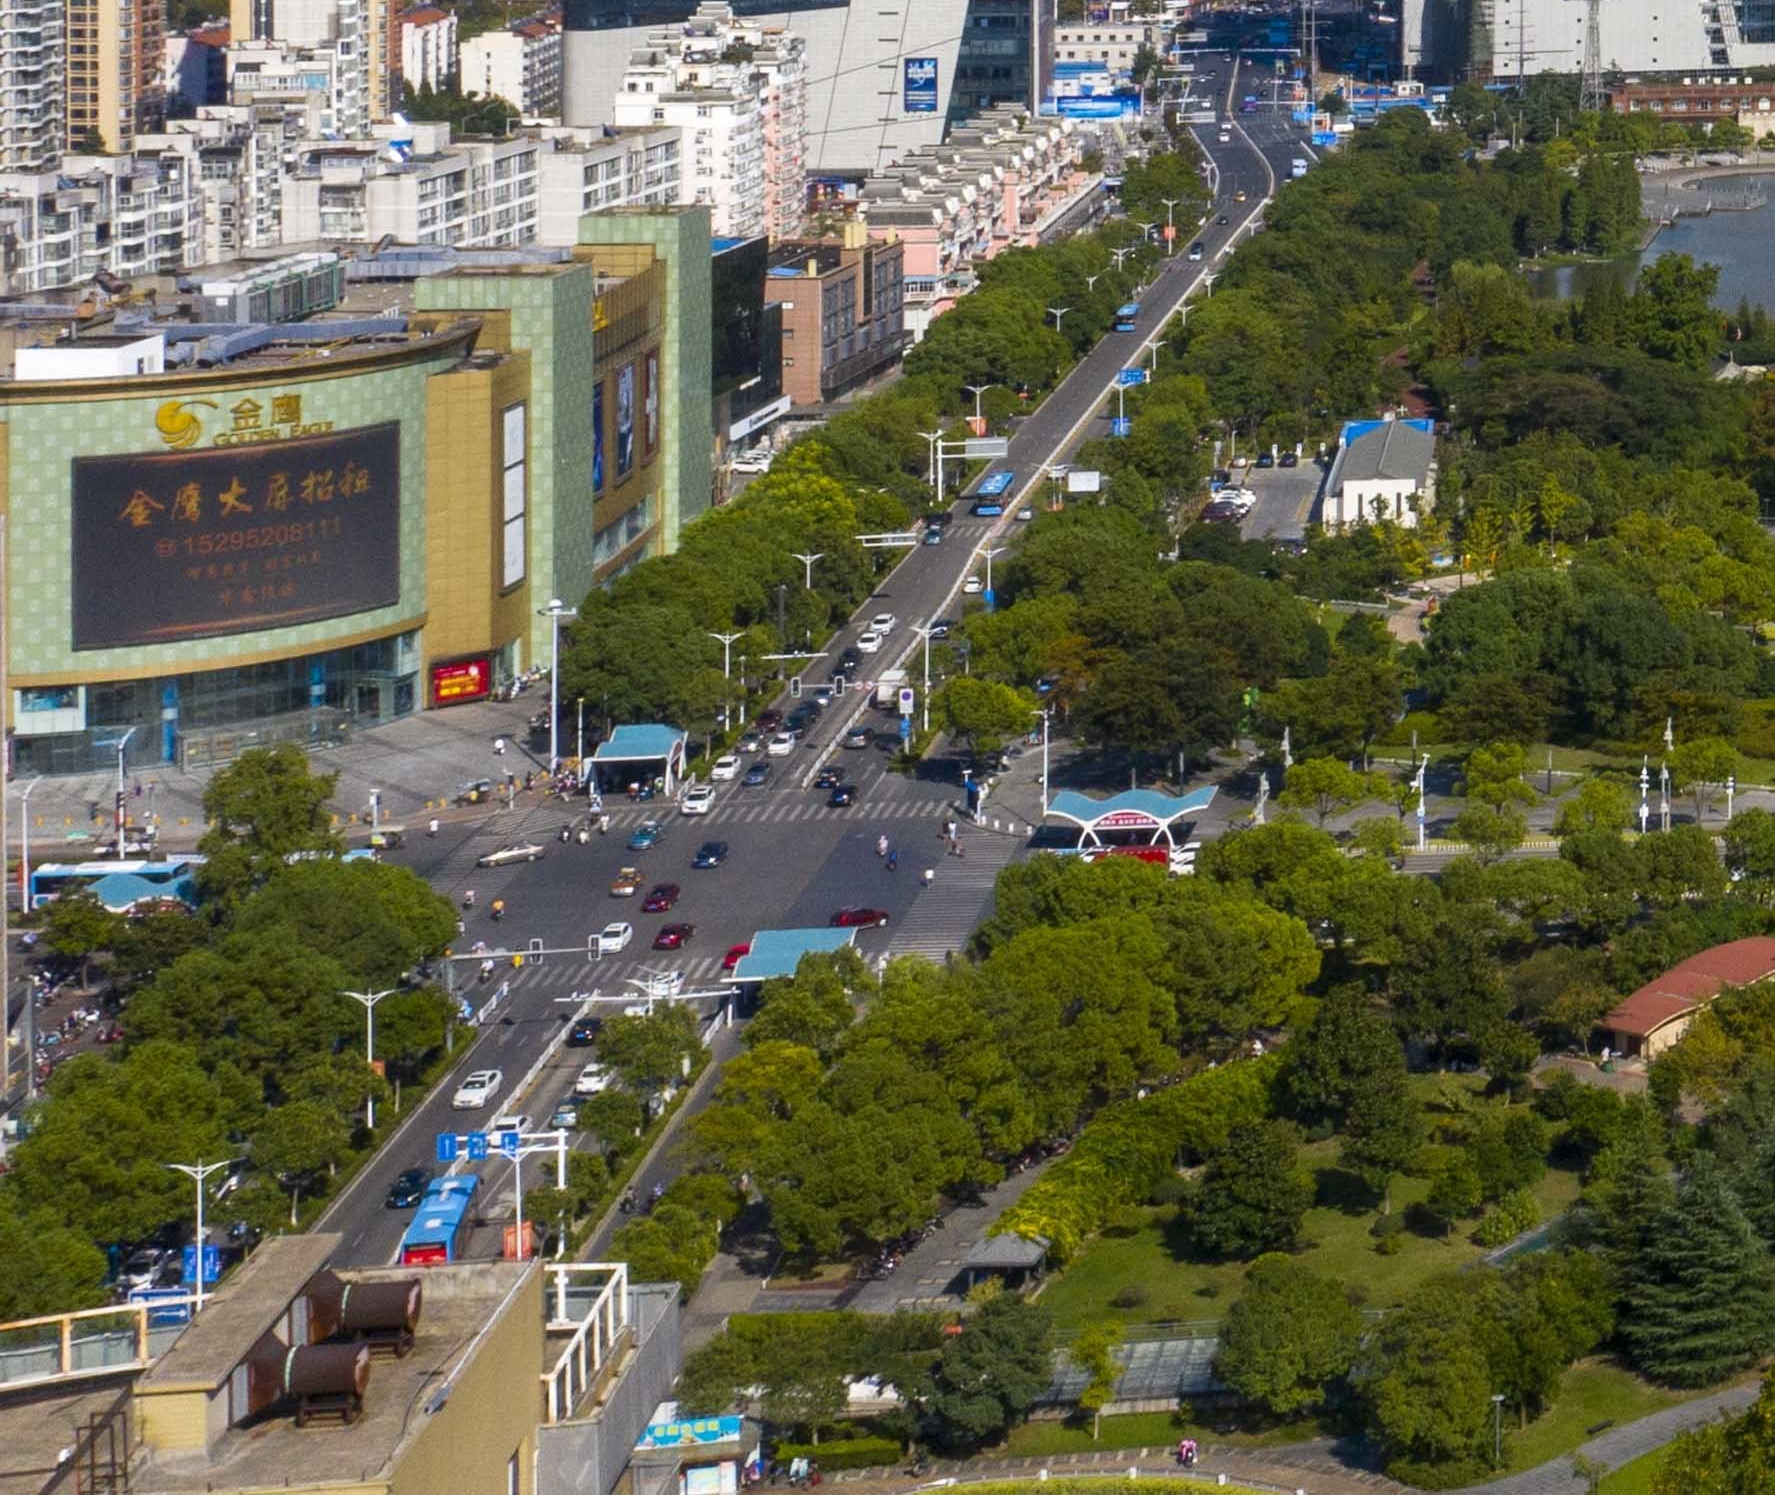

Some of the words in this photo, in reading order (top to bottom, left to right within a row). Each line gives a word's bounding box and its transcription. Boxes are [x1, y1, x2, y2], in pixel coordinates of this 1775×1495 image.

[230, 394, 302, 430] 金鹰
[214, 428, 279, 446] GOLDEN
[292, 421, 333, 437] EAGLE
[118, 460, 373, 528] 金鹰大屏招租
[183, 517, 341, 556] 15295208111
